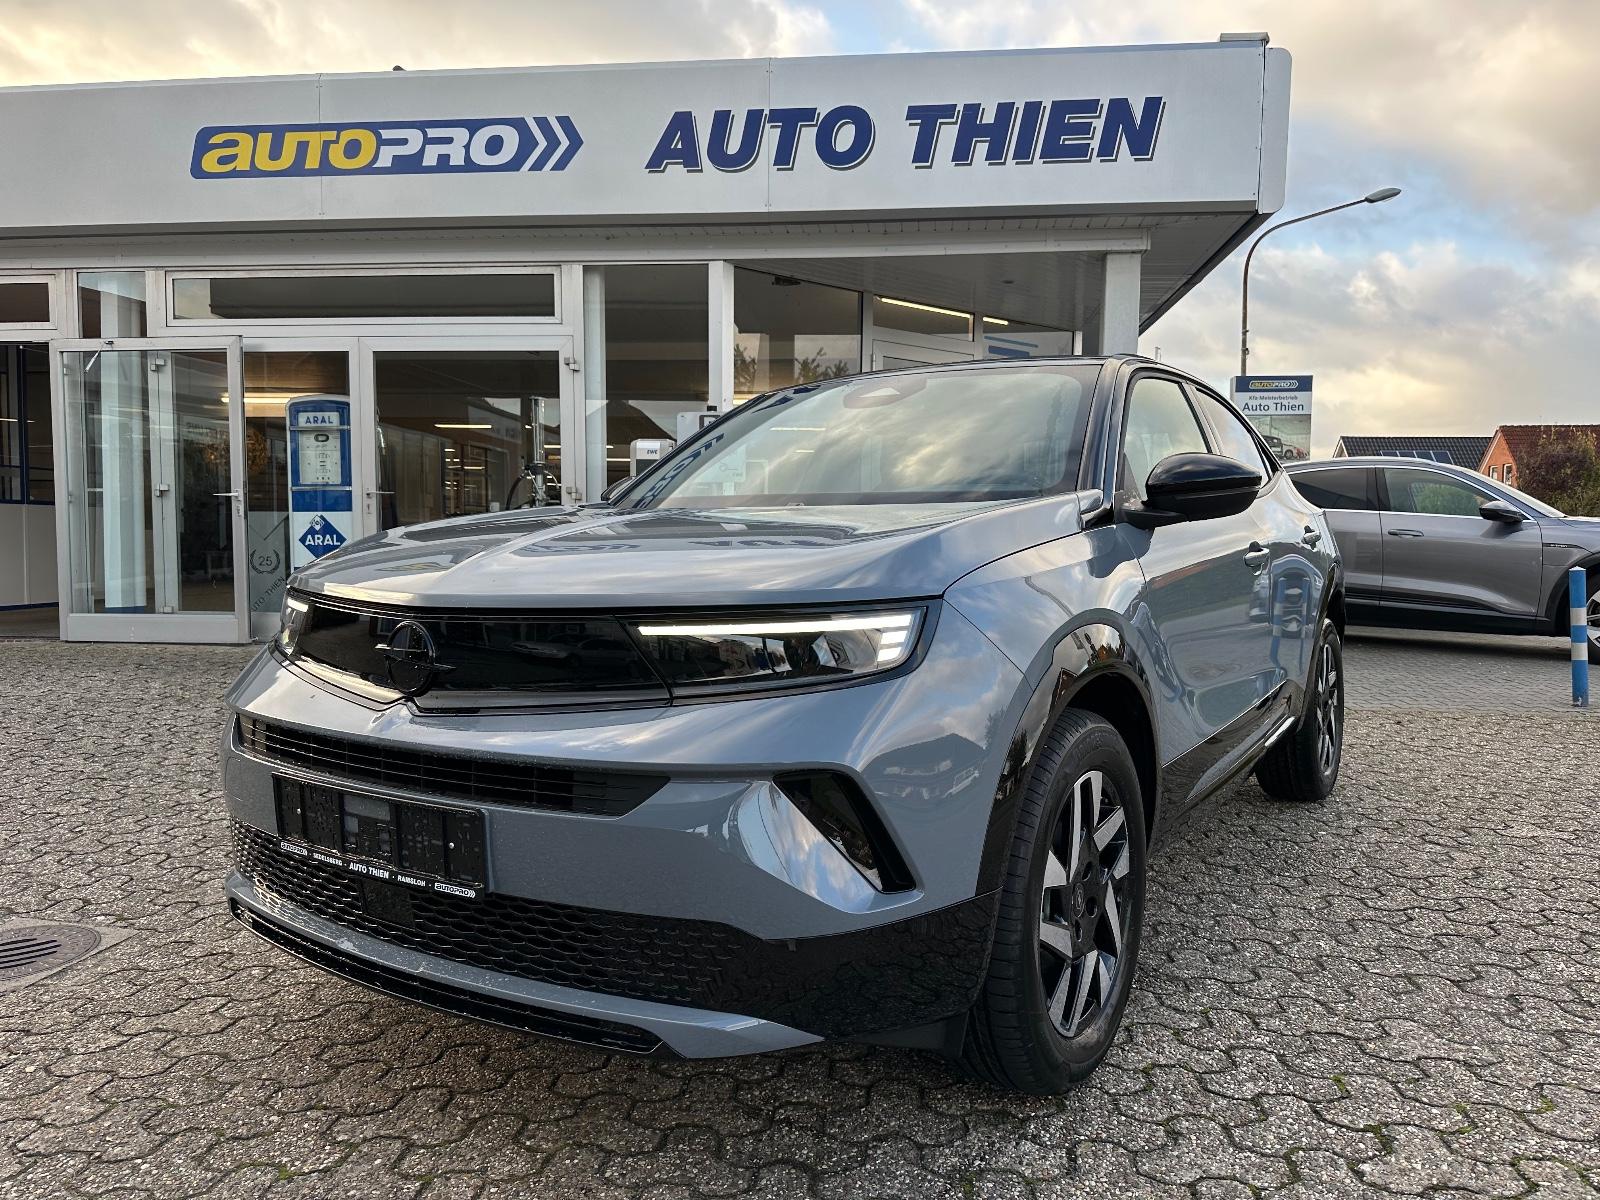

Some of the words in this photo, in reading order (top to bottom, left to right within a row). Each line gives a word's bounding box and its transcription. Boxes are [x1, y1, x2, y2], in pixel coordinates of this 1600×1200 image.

[644, 105, 876, 174] AUTO
[905, 96, 1167, 170] THIEN
[1242, 402, 1270, 412] Auto
[1273, 402, 1304, 411] Thien
[305, 416, 333, 424] ARAL
[305, 534, 340, 546] ARAL
[258, 555, 273, 567] 25
[349, 861, 367, 874] AUTO
[369, 866, 389, 880] THIEN
[397, 874, 426, 887] RAMSLOH
